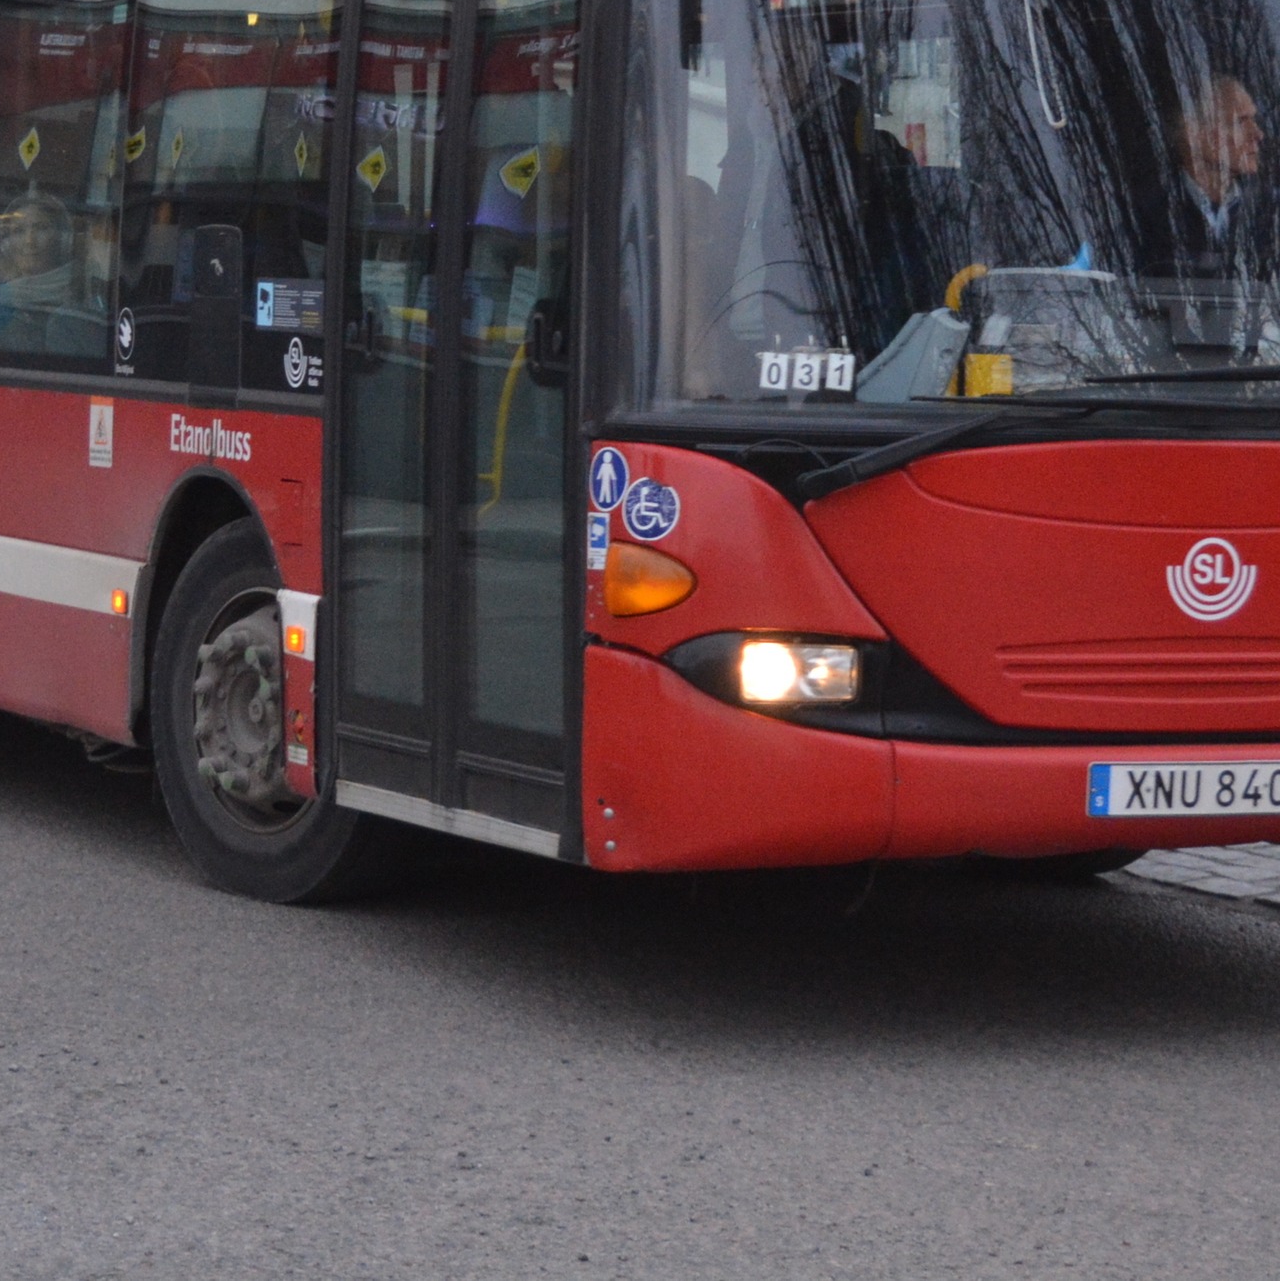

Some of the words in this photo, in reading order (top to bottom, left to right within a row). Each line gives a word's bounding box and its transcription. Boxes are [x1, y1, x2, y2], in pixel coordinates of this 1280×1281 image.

[170, 413, 251, 462] Etanolbuss
[1193, 553, 1231, 585] SL
[1125, 770, 1202, 810] XNU
